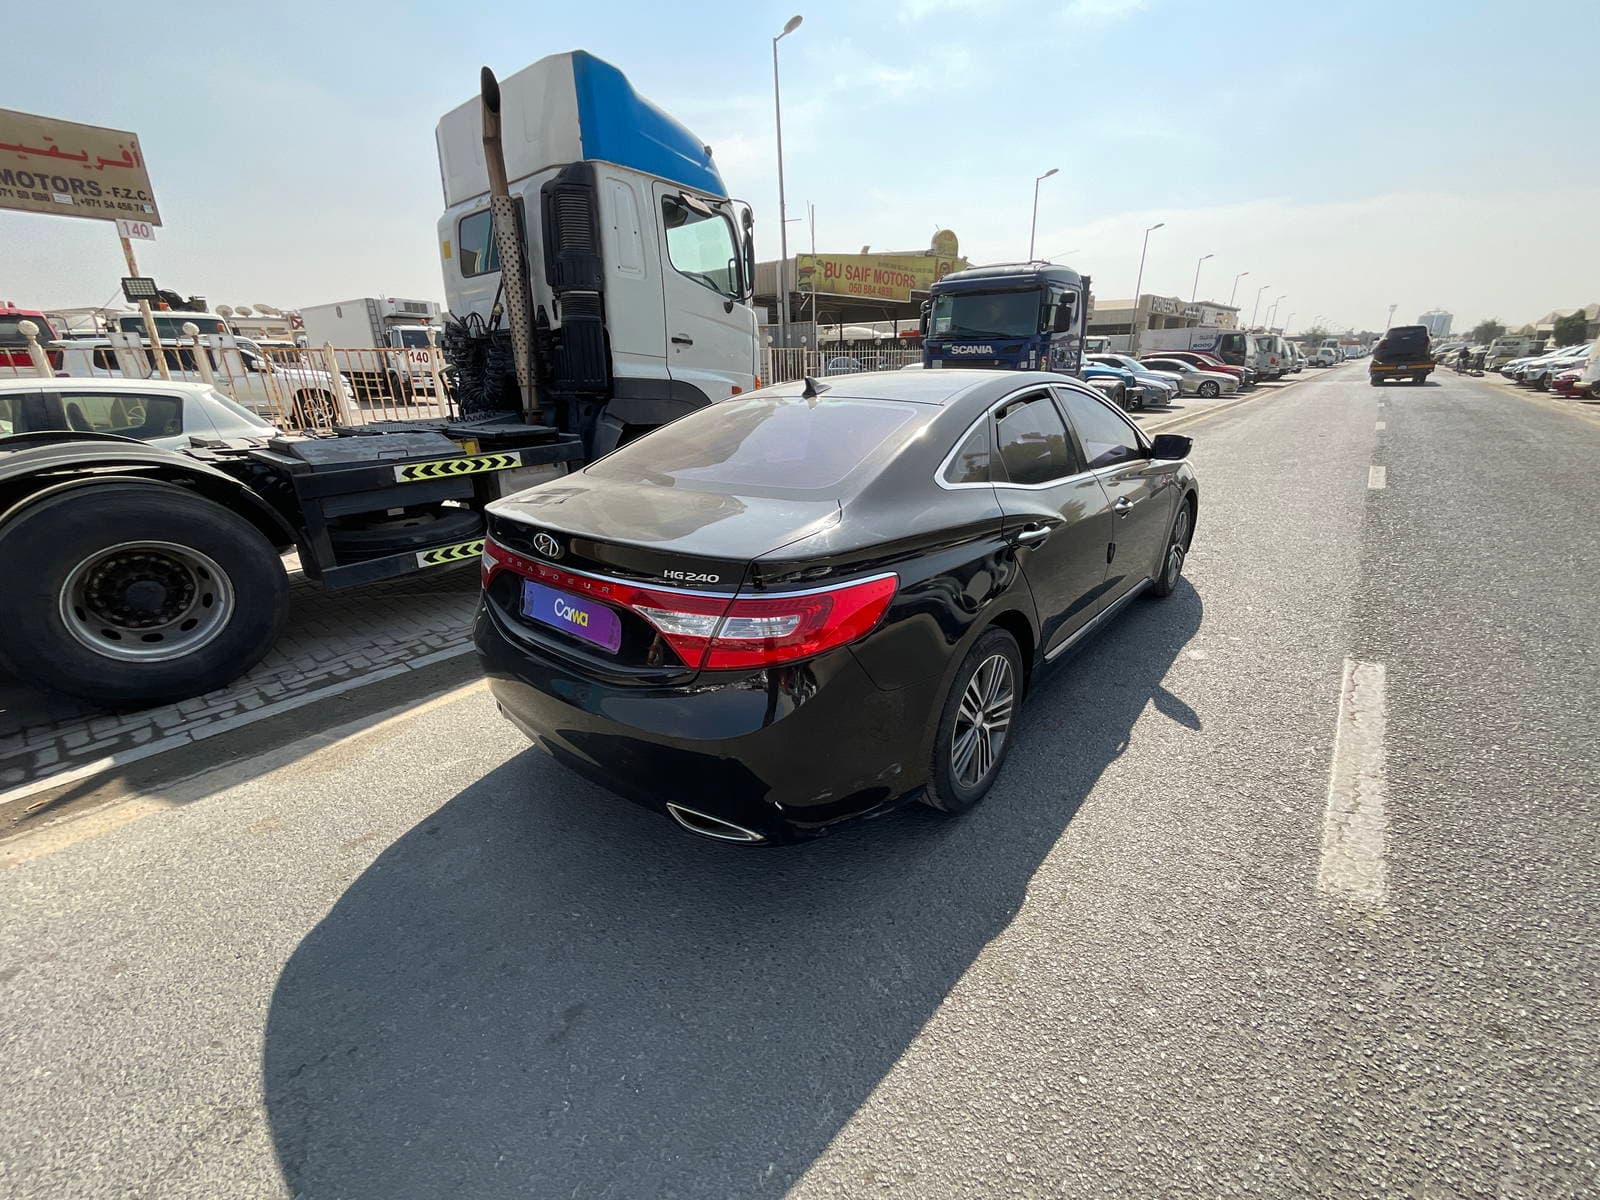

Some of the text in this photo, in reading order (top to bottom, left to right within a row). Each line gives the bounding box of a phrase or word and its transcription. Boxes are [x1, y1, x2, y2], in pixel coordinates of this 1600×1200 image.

[0, 168, 102, 197] MOTORS
[122, 221, 150, 238] 140
[824, 262, 842, 279] BU
[845, 265, 872, 284] SAIF
[874, 271, 917, 289] MOTORS
[849, 282, 863, 294] 050
[410, 351, 429, 363] 140
[951, 345, 994, 355] SCANIA
[507, 557, 611, 593] GRANDEUR
[554, 597, 590, 628] Carwa
